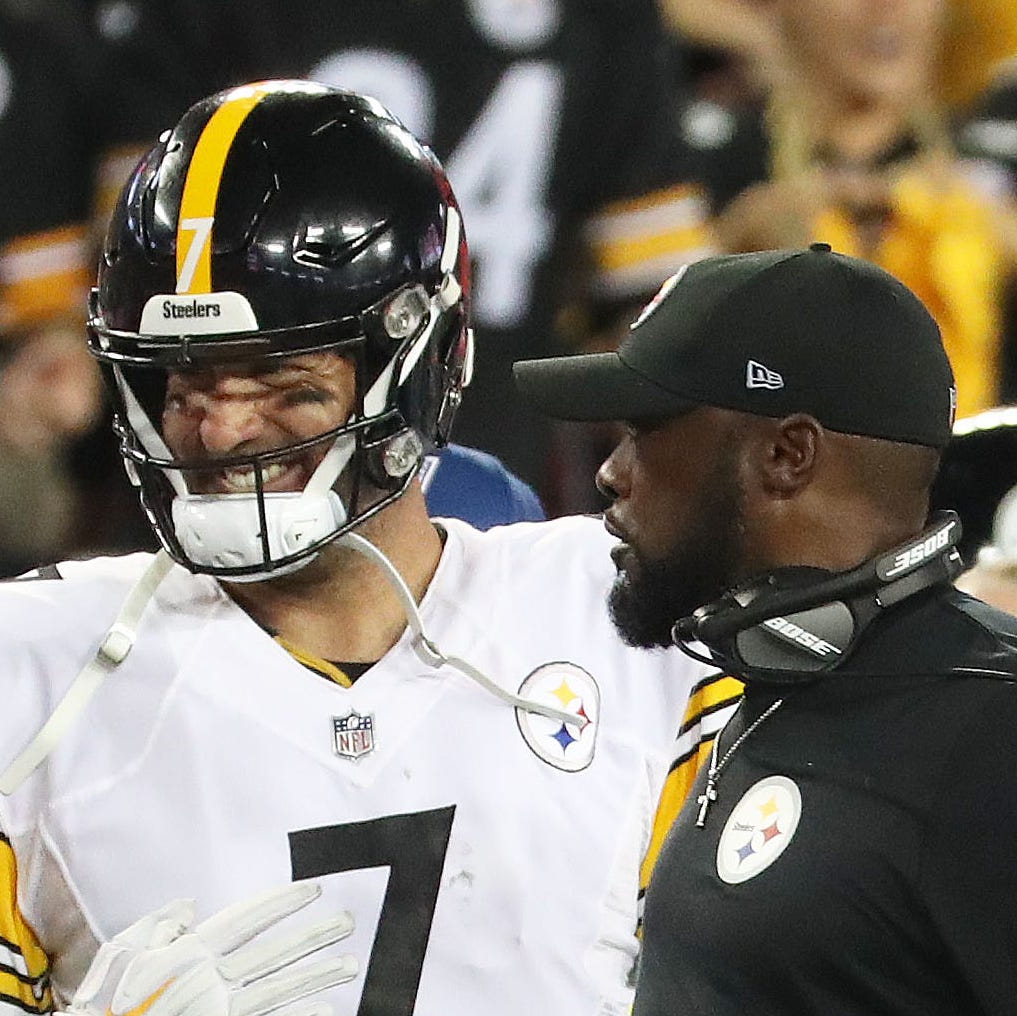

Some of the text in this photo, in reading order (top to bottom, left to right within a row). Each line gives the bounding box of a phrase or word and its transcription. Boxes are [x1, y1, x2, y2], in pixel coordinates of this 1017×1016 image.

[175, 216, 214, 294] 7
[163, 299, 220, 319] Steelers
[885, 521, 956, 577] BOSE
[763, 616, 843, 656] BOSE
[339, 731, 370, 753] NFL
